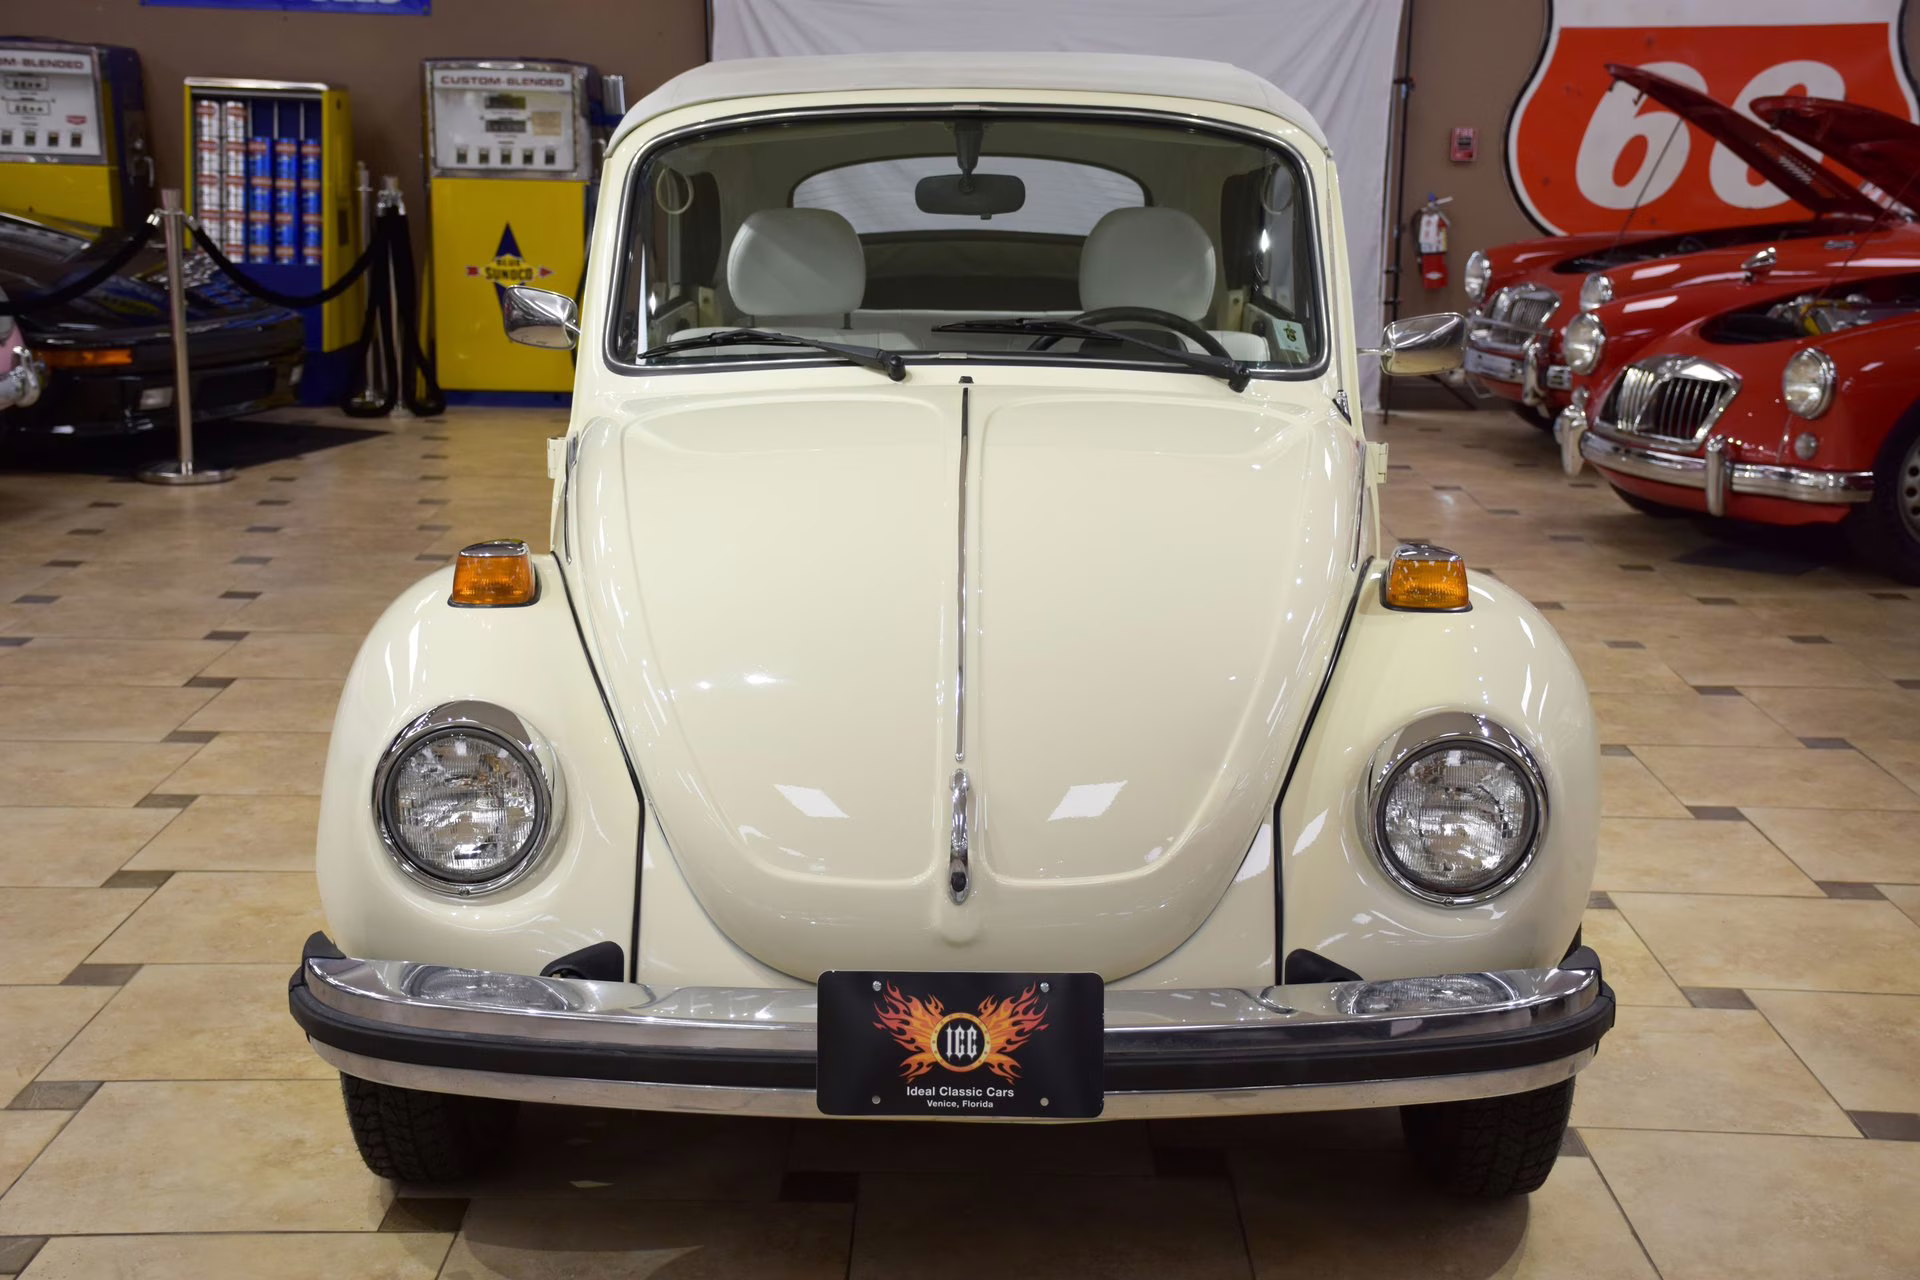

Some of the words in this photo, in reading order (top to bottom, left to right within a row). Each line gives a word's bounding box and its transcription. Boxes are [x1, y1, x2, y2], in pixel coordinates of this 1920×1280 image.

[1575, 60, 1846, 209] 66
[946, 1025, 977, 1060] ICC
[906, 1086, 936, 1096] Ideal
[939, 1086, 983, 1097] Classic
[986, 1087, 1015, 1098] Cars
[927, 1099, 960, 1109] Venice,
[962, 1100, 994, 1109] Florida
